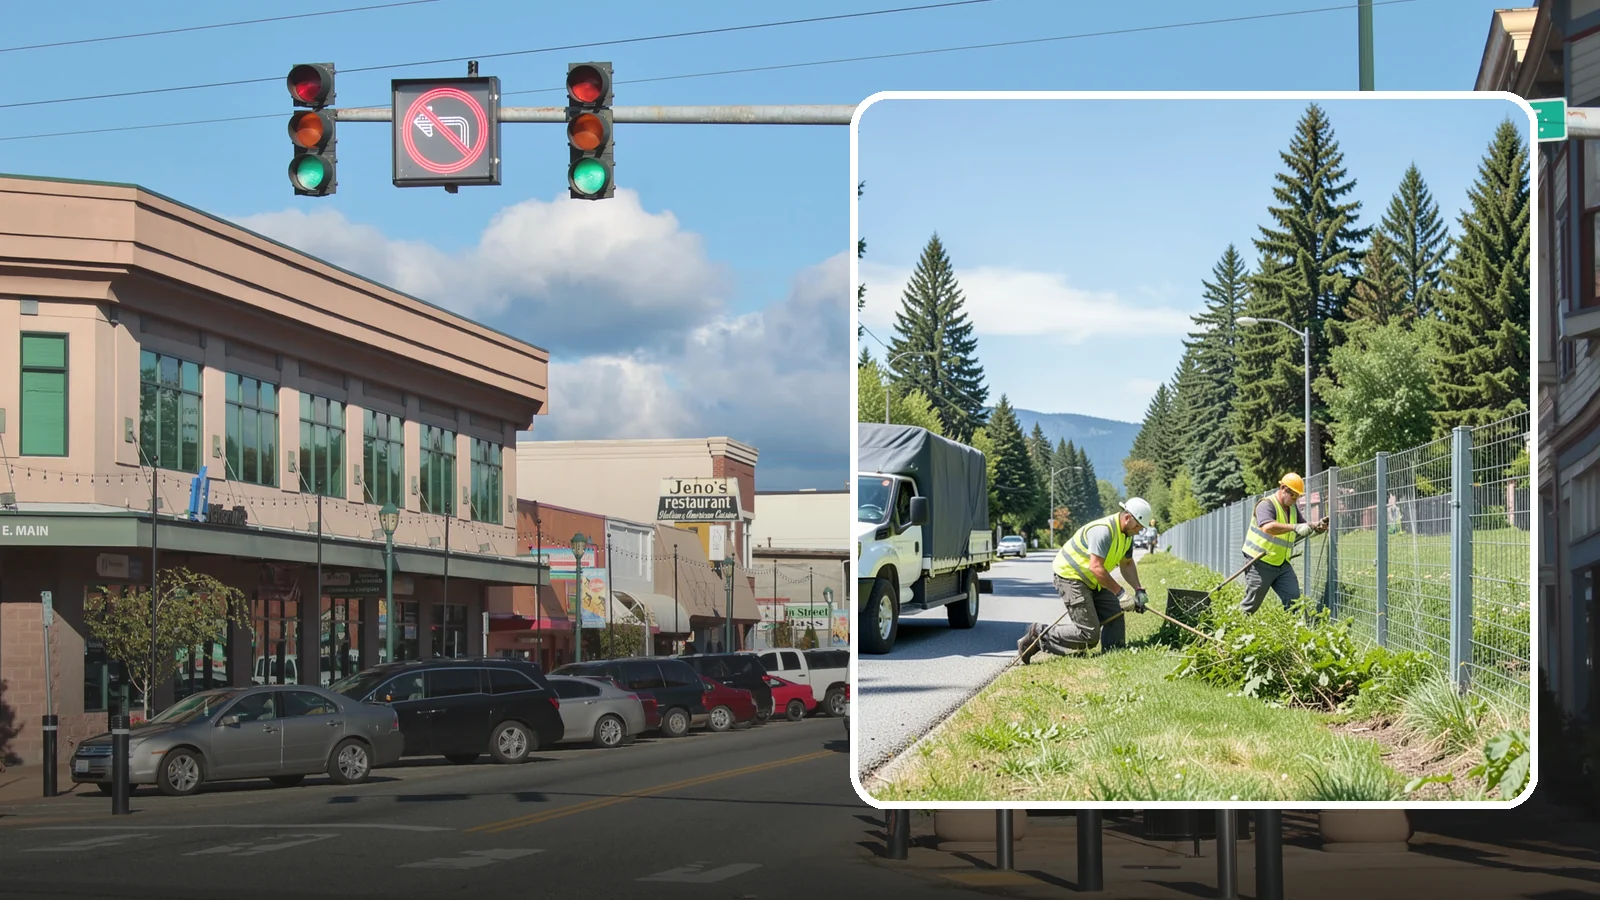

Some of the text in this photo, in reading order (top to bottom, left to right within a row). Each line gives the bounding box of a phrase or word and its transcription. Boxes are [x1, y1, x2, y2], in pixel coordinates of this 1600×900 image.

[669, 480, 727, 494] Jeno's
[665, 496, 731, 509] restaurant
[658, 510, 681, 520] Italian
[686, 510, 715, 519] American
[715, 509, 737, 519] Cuisine
[2, 525, 49, 536] E. MAIN
[797, 607, 828, 616] Street
